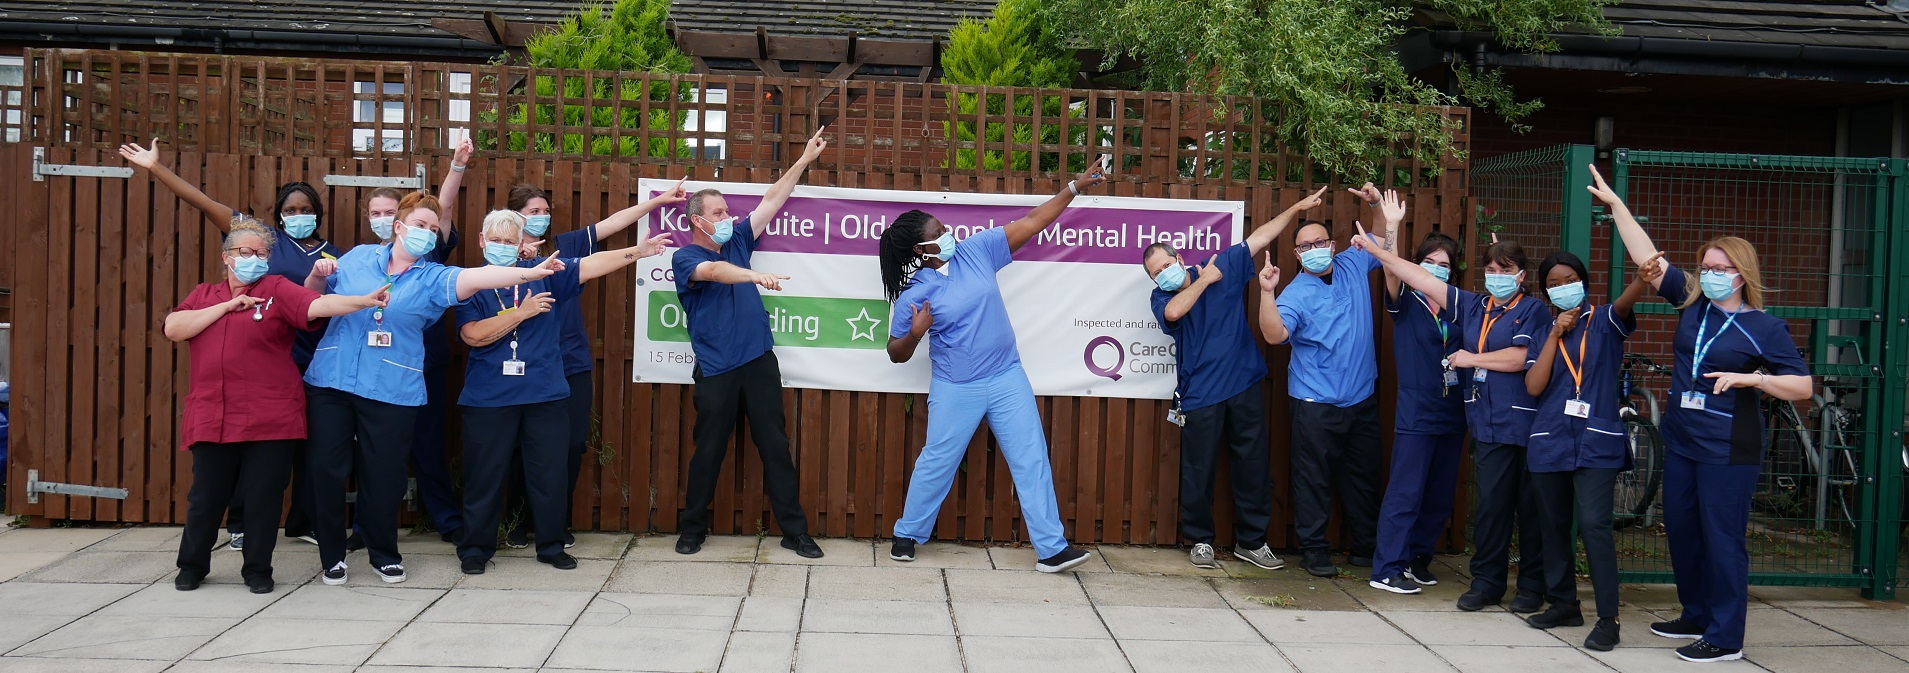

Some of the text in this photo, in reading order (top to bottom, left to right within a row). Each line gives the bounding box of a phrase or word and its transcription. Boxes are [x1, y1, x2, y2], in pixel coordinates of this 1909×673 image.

[746, 211, 815, 237] uite
[840, 213, 892, 240] Old
[1037, 222, 1127, 248] Mental
[1137, 224, 1221, 251] Health
[650, 267, 675, 282] CQ
[1074, 318, 1161, 330] Inspected and rat
[649, 351, 664, 363] 15
